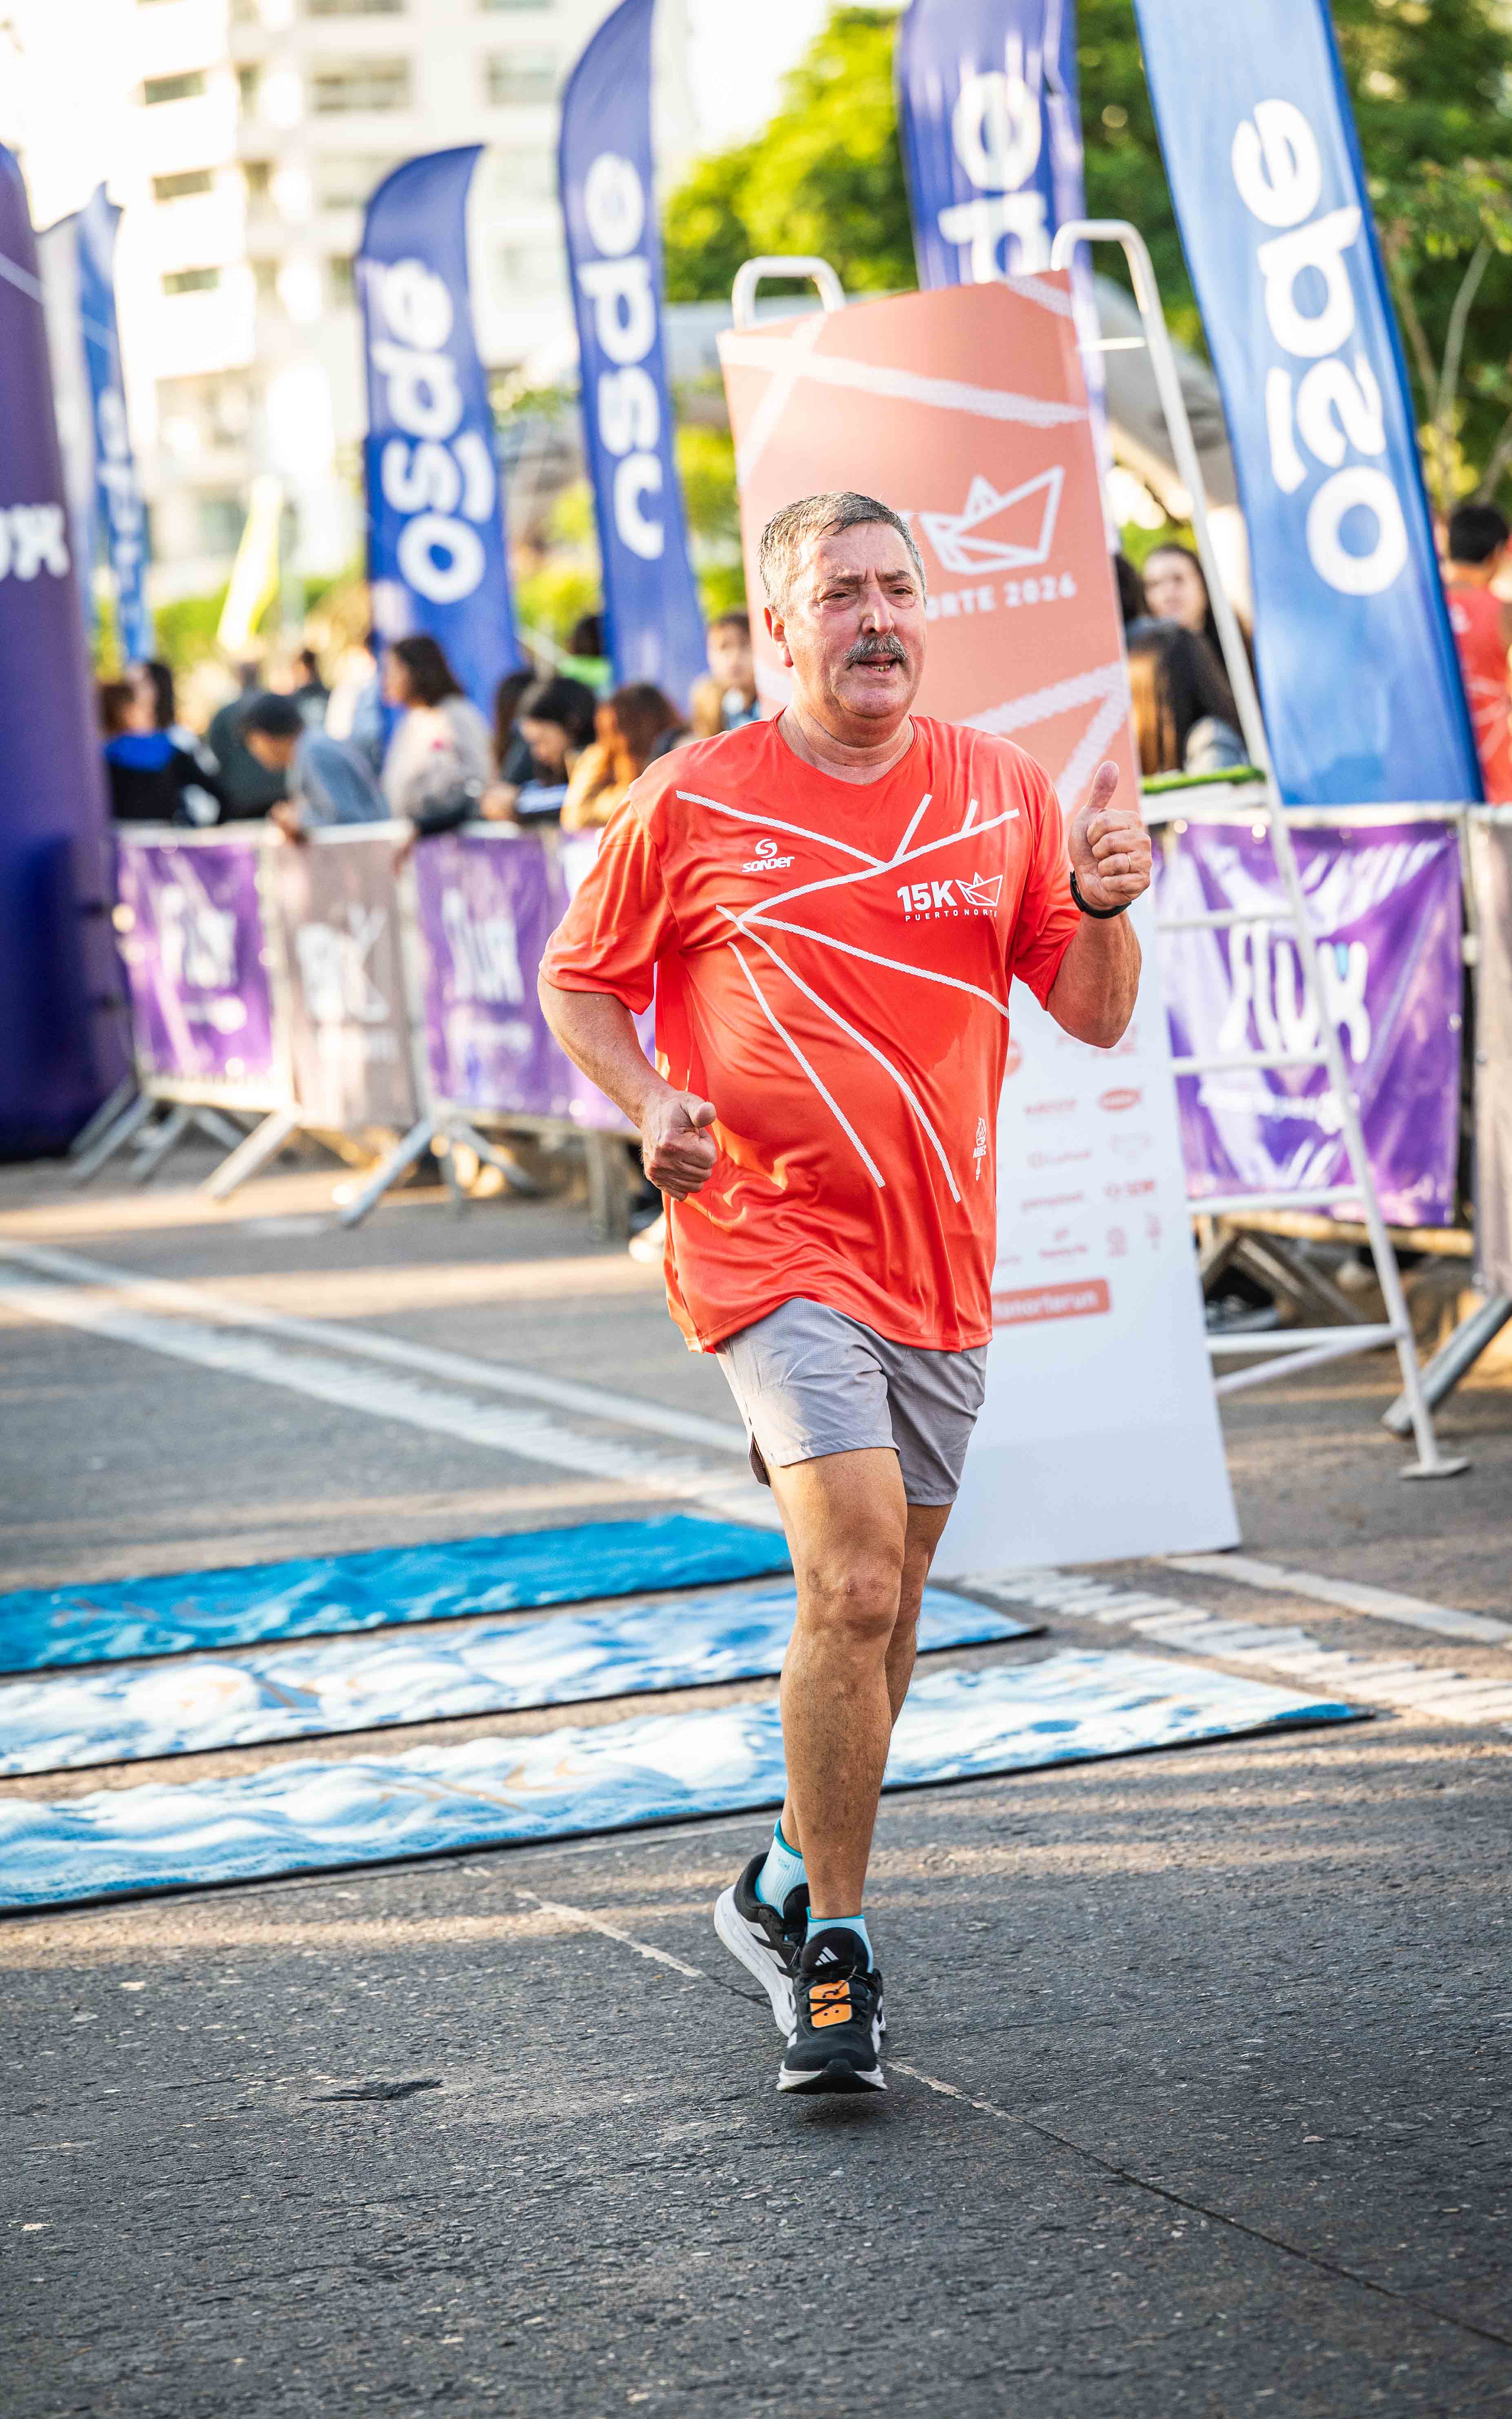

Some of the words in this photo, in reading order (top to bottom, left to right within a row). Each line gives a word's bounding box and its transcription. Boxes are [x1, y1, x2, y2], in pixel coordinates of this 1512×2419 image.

[897, 880, 958, 913] 15K
[905, 909, 959, 922] PUERTO
[964, 909, 998, 918] NORTE
